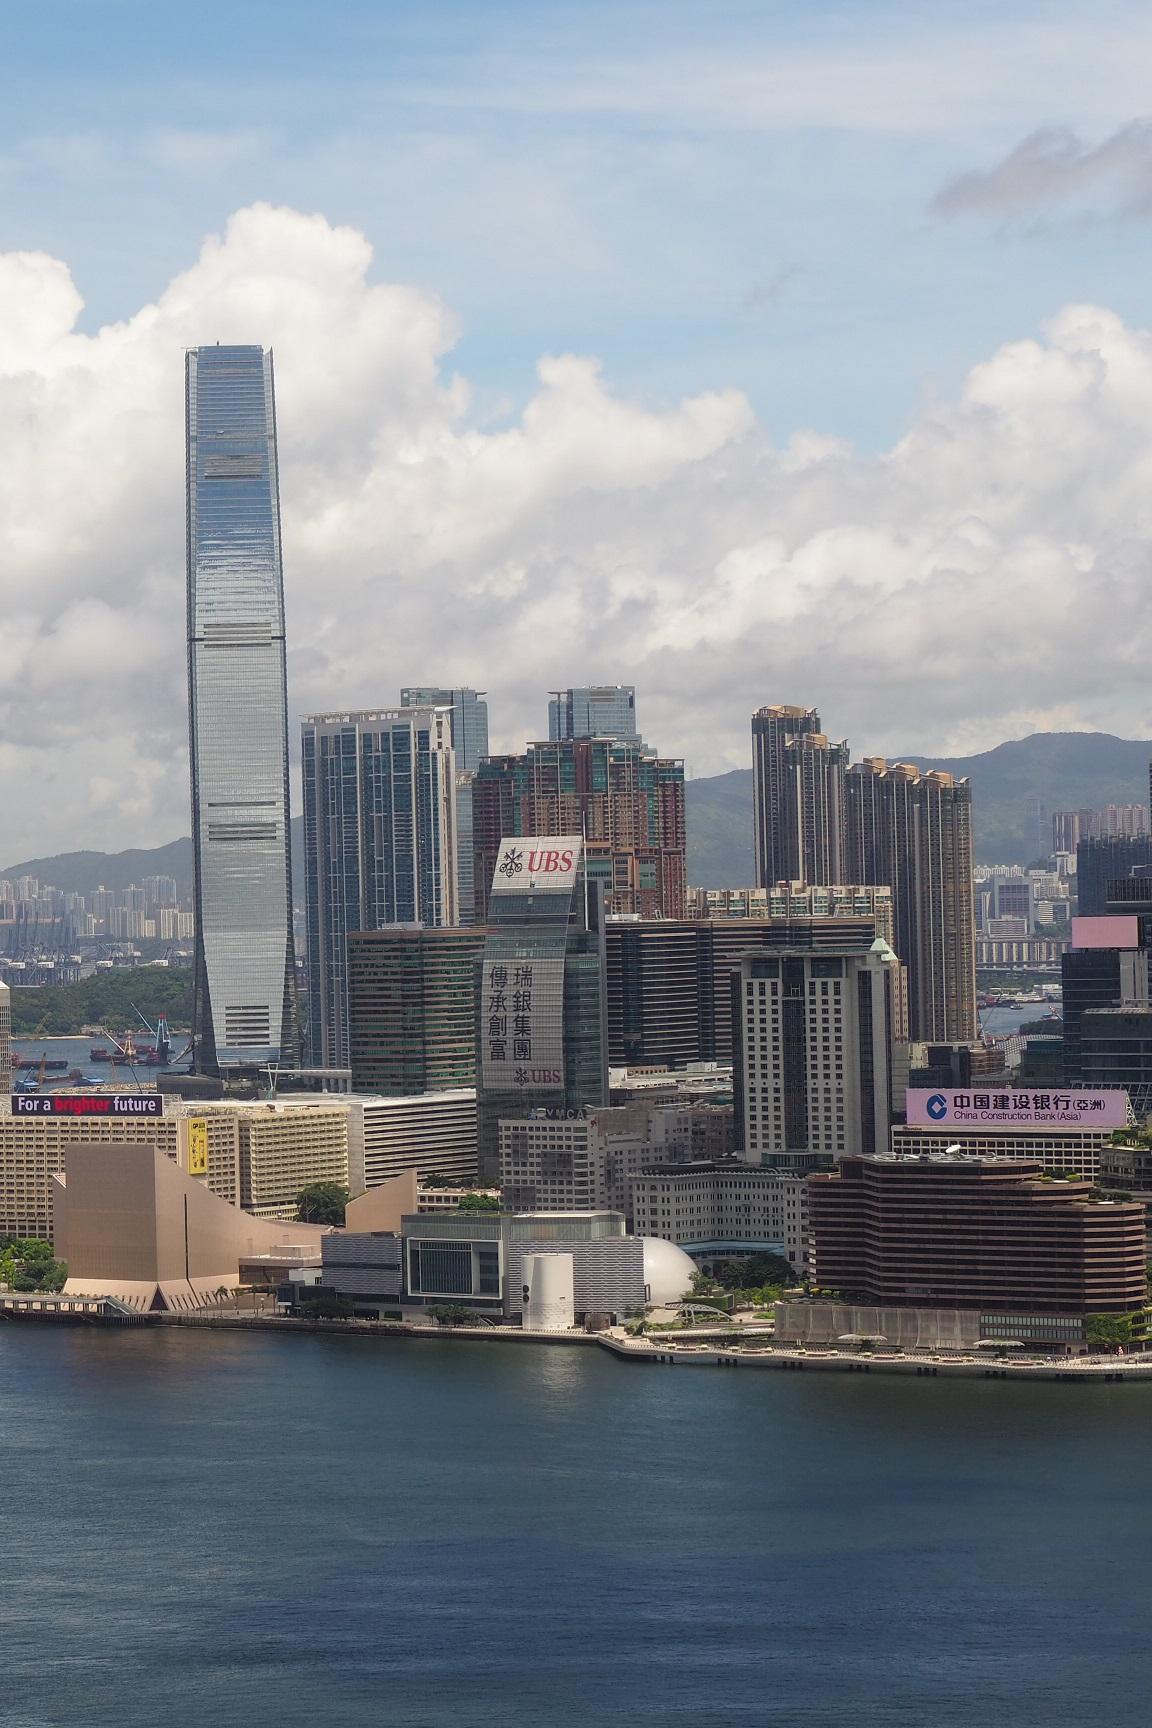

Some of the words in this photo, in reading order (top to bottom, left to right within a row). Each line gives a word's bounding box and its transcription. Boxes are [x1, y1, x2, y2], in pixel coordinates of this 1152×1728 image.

[528, 850, 573, 872] UBS
[488, 966, 508, 1061] 傳承創富
[512, 966, 533, 1061] 瑞銀集團
[531, 1069, 561, 1084] UBS
[18, 1097, 39, 1111] For
[43, 1100, 51, 1111] a
[54, 1097, 110, 1115] brighter
[113, 1096, 156, 1111] future
[954, 1110, 978, 1120] China
[980, 1111, 1032, 1121] Construction
